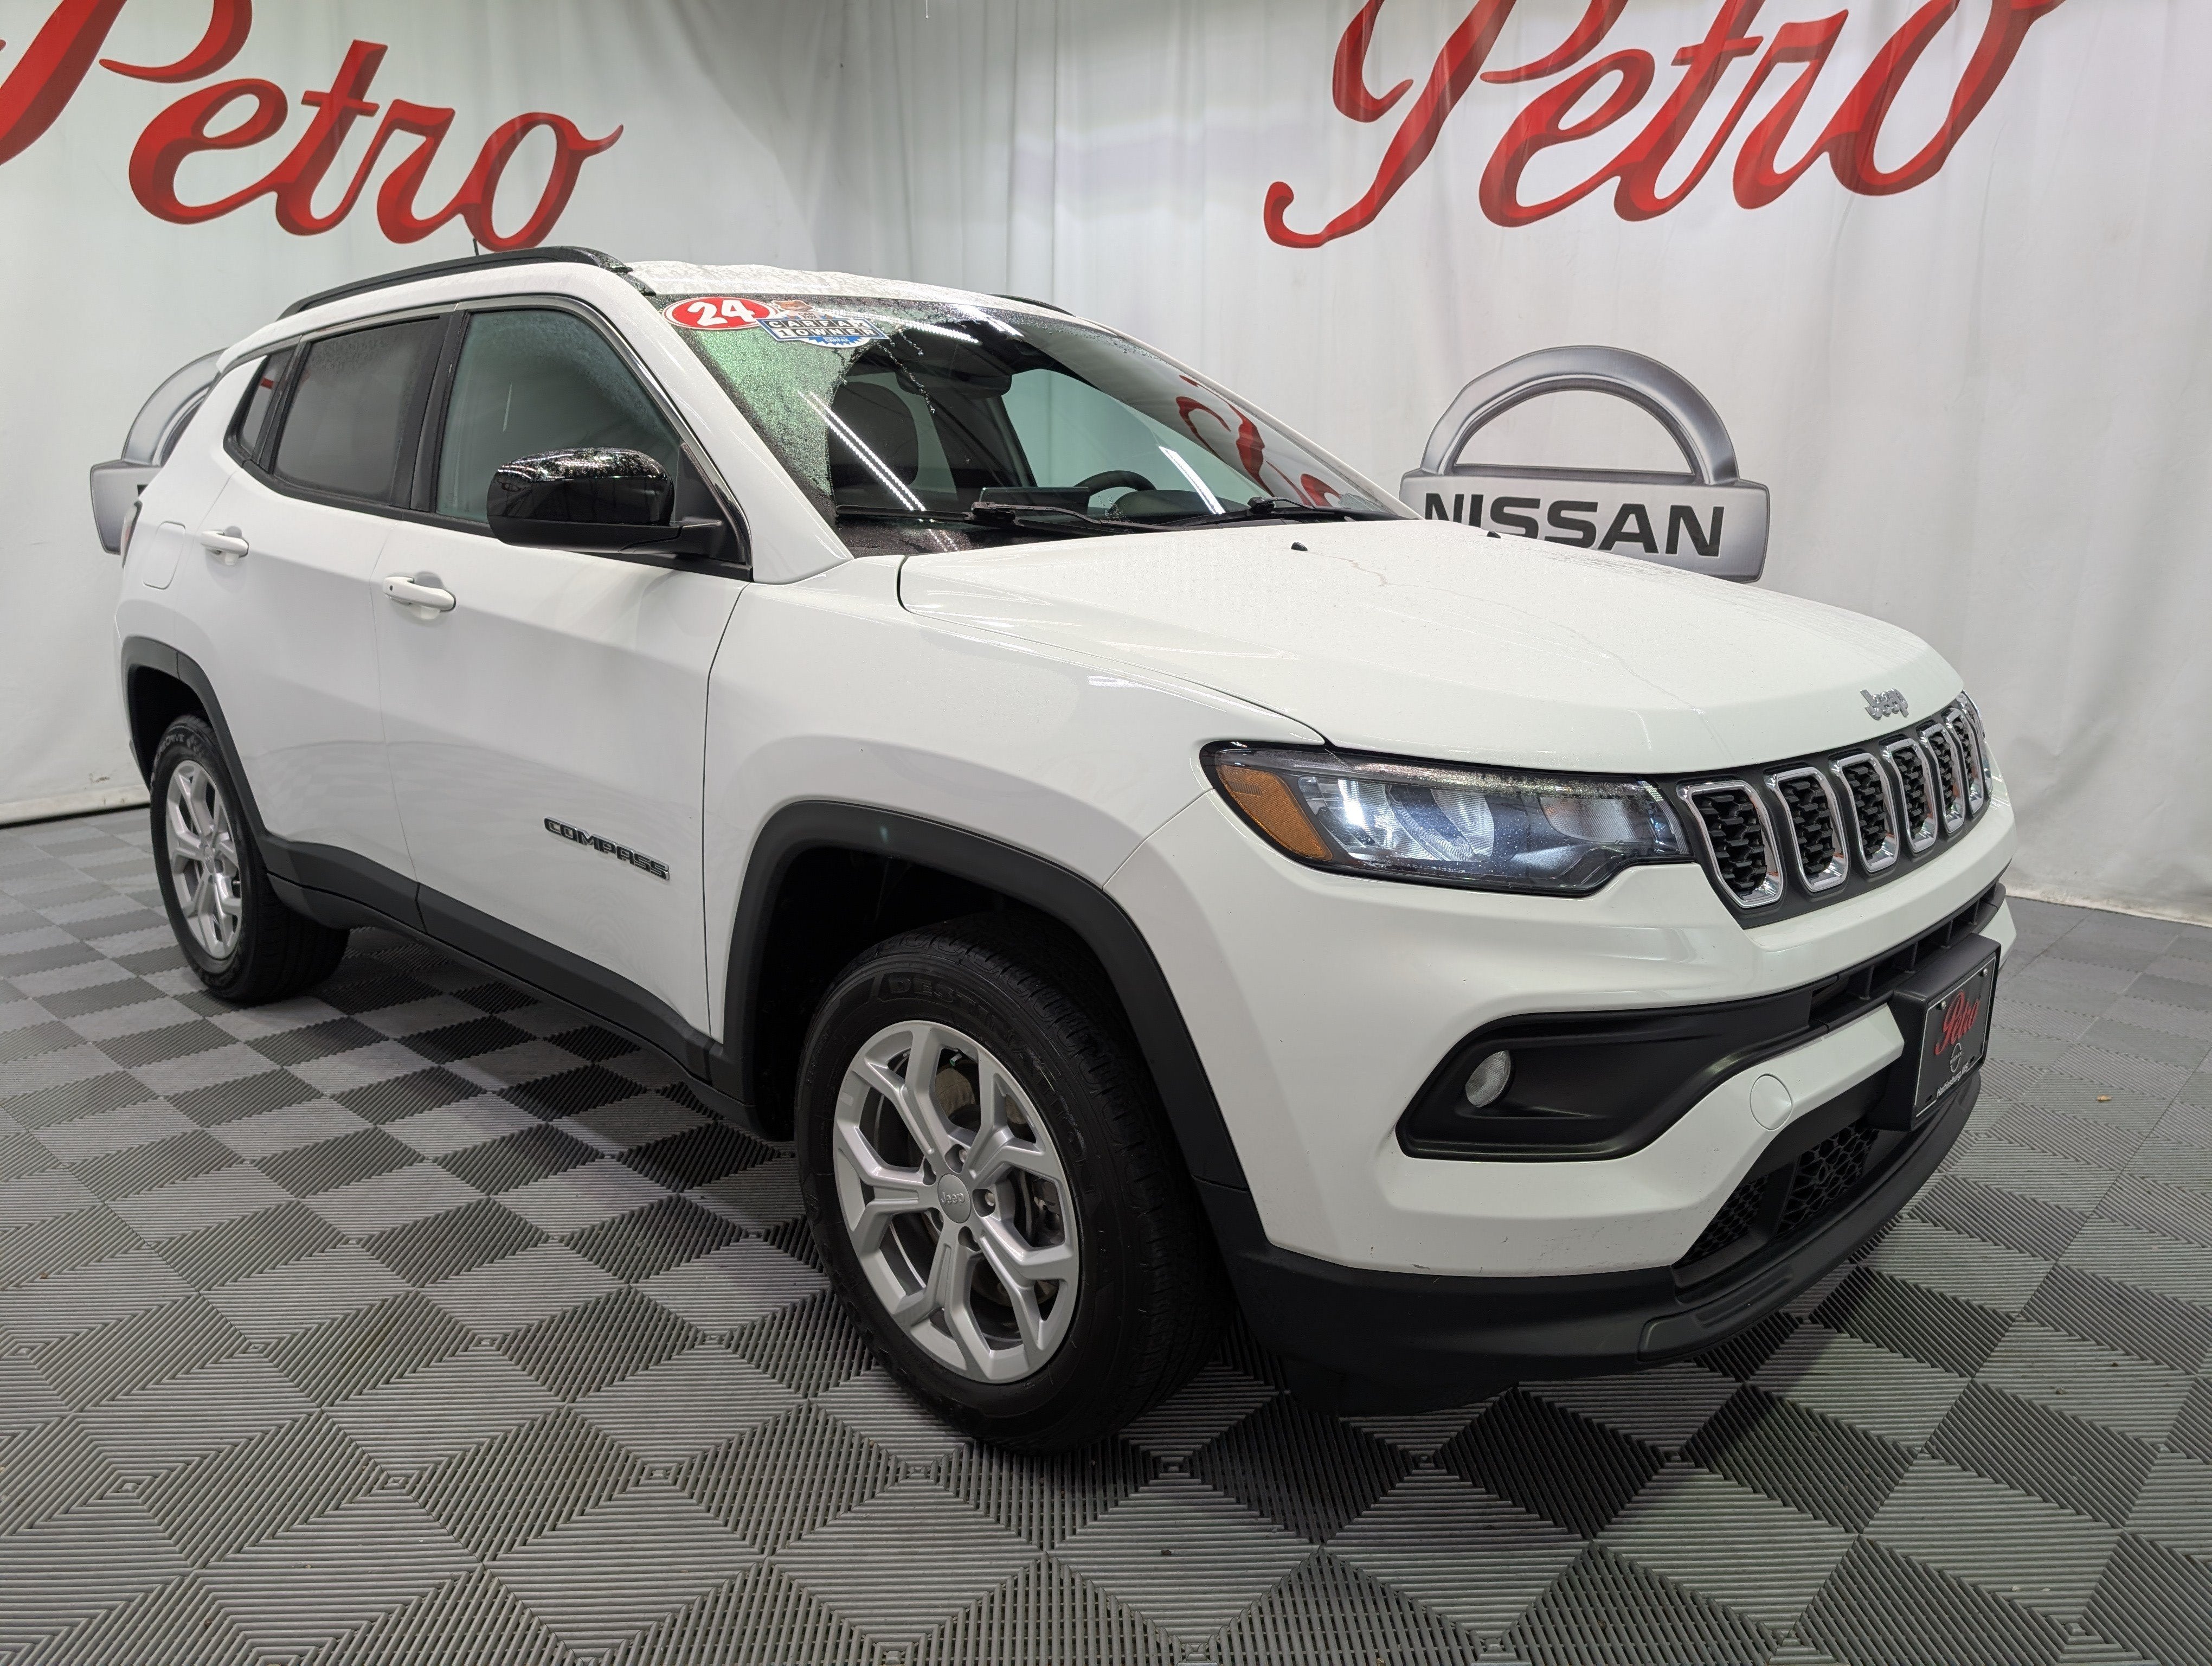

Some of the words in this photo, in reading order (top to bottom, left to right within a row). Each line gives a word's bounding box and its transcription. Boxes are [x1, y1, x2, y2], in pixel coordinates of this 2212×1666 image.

[687, 299, 756, 326] 24
[1424, 492, 1725, 558] NISSAN
[1860, 688, 1909, 721] Jeep
[544, 816, 670, 881] COMPASS
[940, 1191, 965, 1206] Jeep
